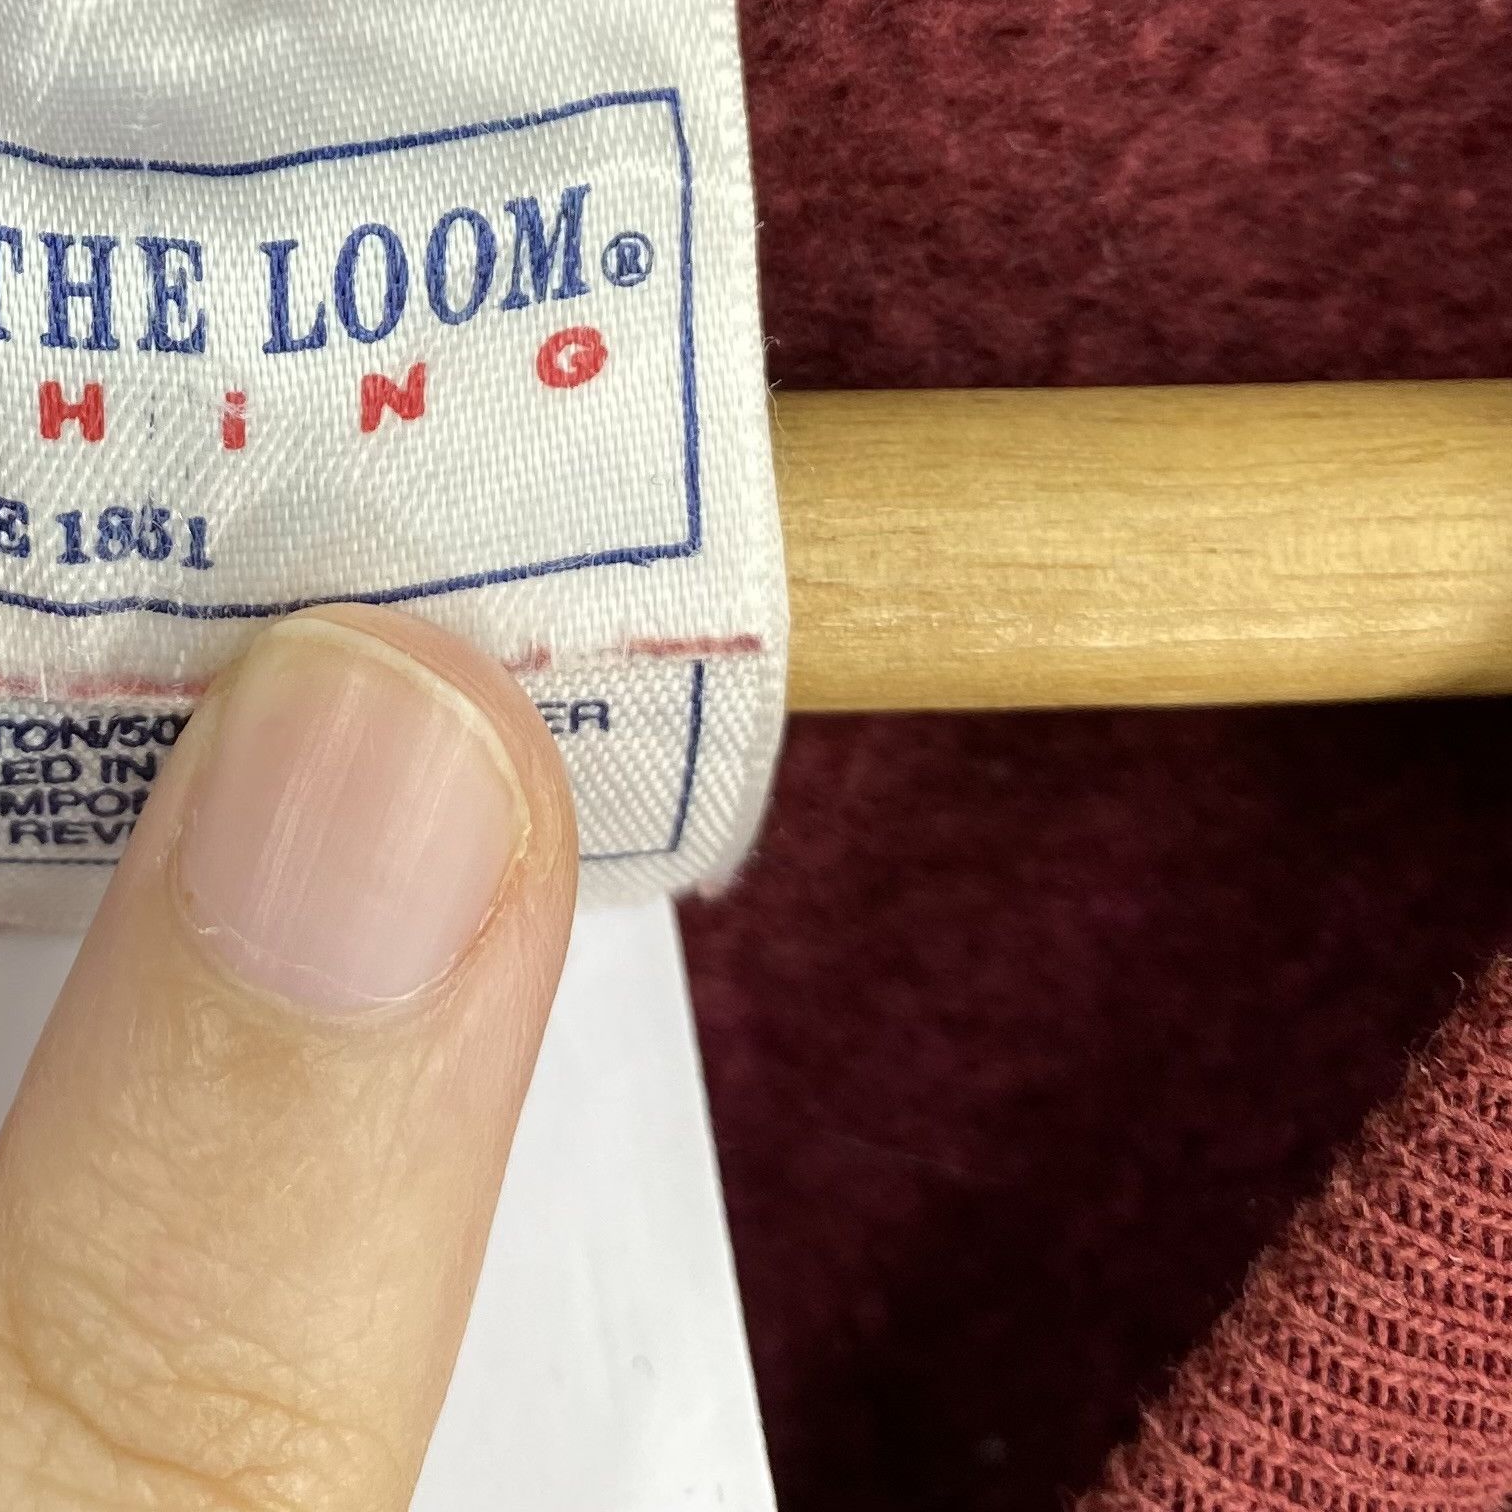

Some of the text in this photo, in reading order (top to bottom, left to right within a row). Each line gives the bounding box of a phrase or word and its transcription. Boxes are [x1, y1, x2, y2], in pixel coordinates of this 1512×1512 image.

[56, 502, 215, 571] 1851
[100, 751, 156, 783] IN
[10, 819, 138, 845] REV
